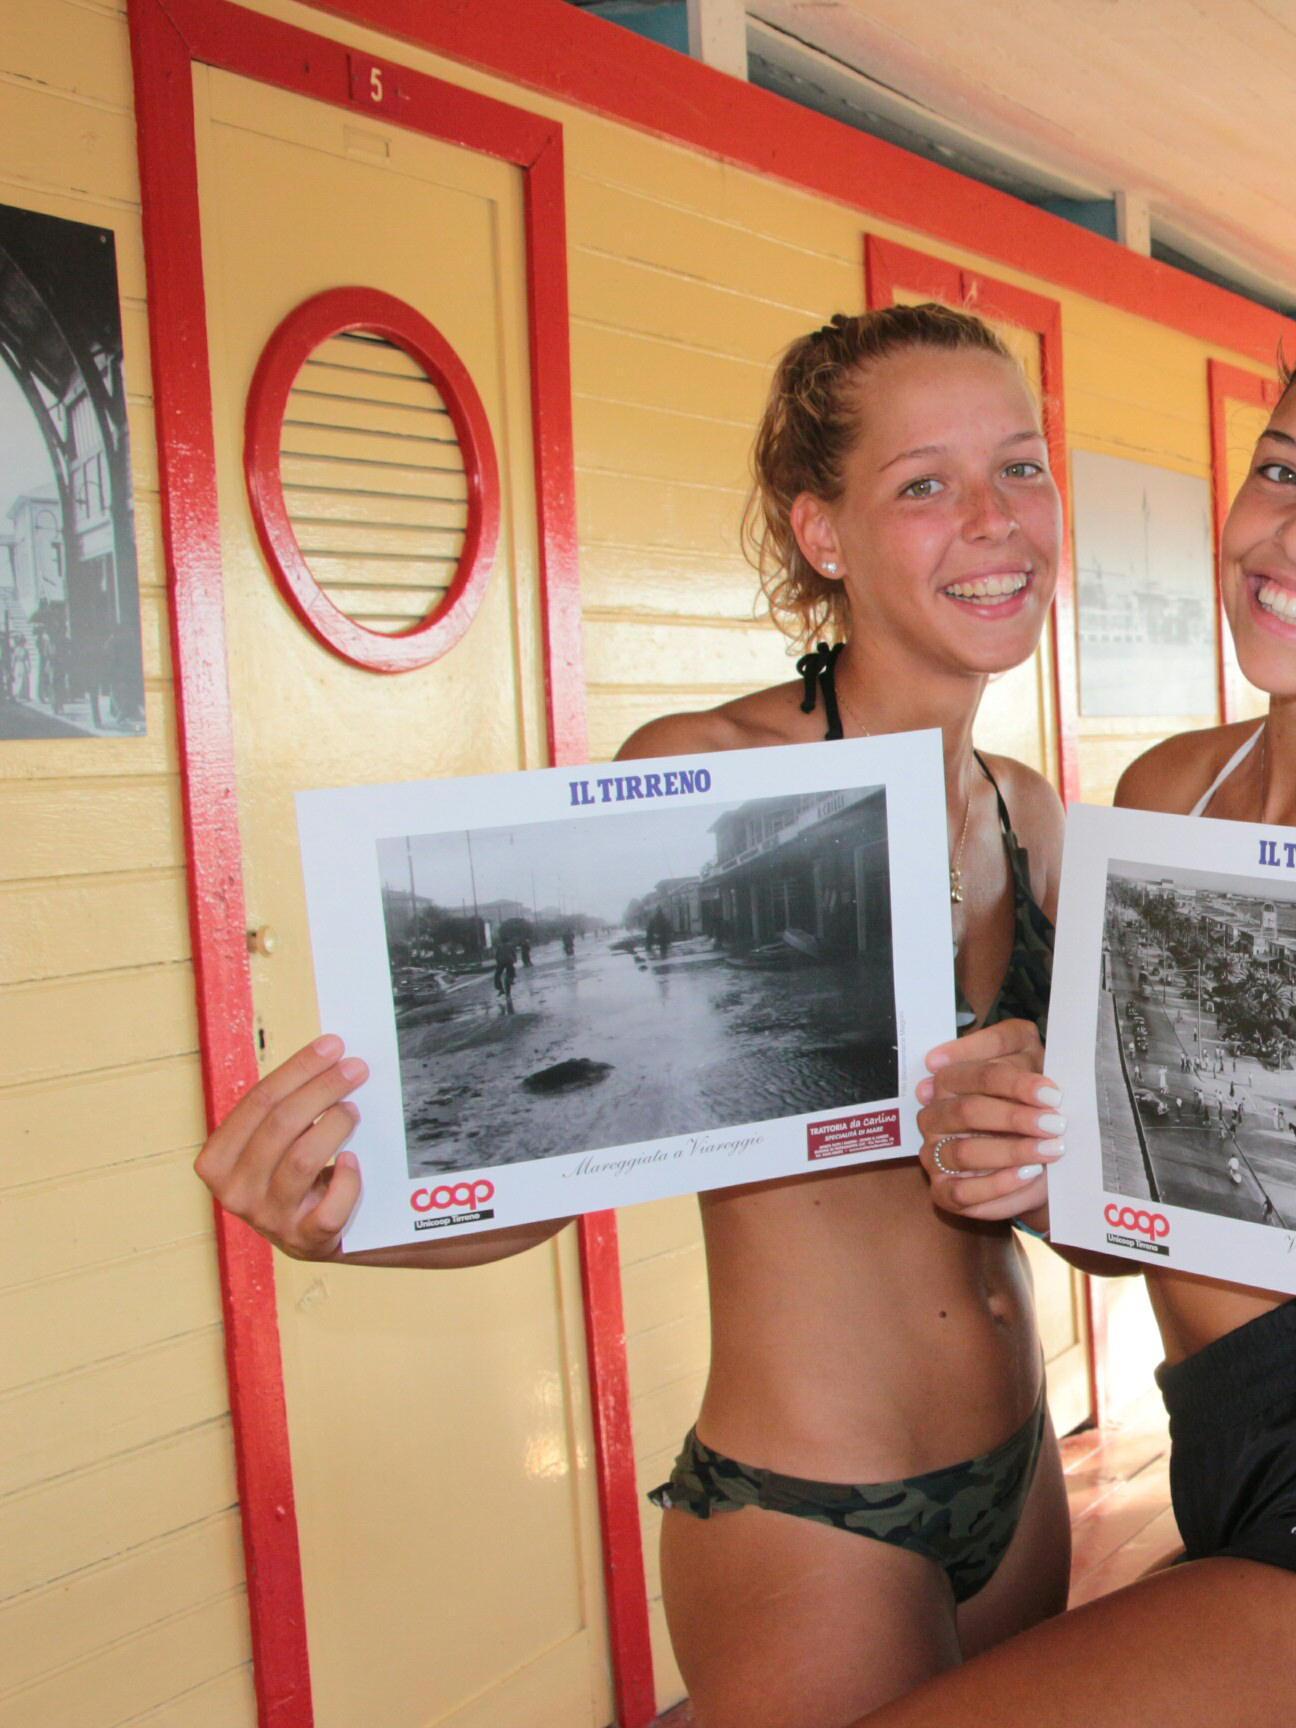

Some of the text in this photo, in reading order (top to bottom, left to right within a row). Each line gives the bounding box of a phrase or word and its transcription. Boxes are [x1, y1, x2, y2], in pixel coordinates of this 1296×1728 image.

[371, 67, 382, 102] 5
[568, 768, 711, 806] IL TIRRENO
[1259, 840, 1280, 866] IL
[810, 1123, 848, 1136] TRATTORIA
[850, 1118, 861, 1129] da
[562, 1131, 765, 1178] Mareggiata a Viareggio
[410, 1179, 495, 1212] coop
[416, 1212, 480, 1229] Unicoop Tirreno
[1104, 1203, 1170, 1242] coop
[1107, 1233, 1159, 1252] Unicoop Tirreno
